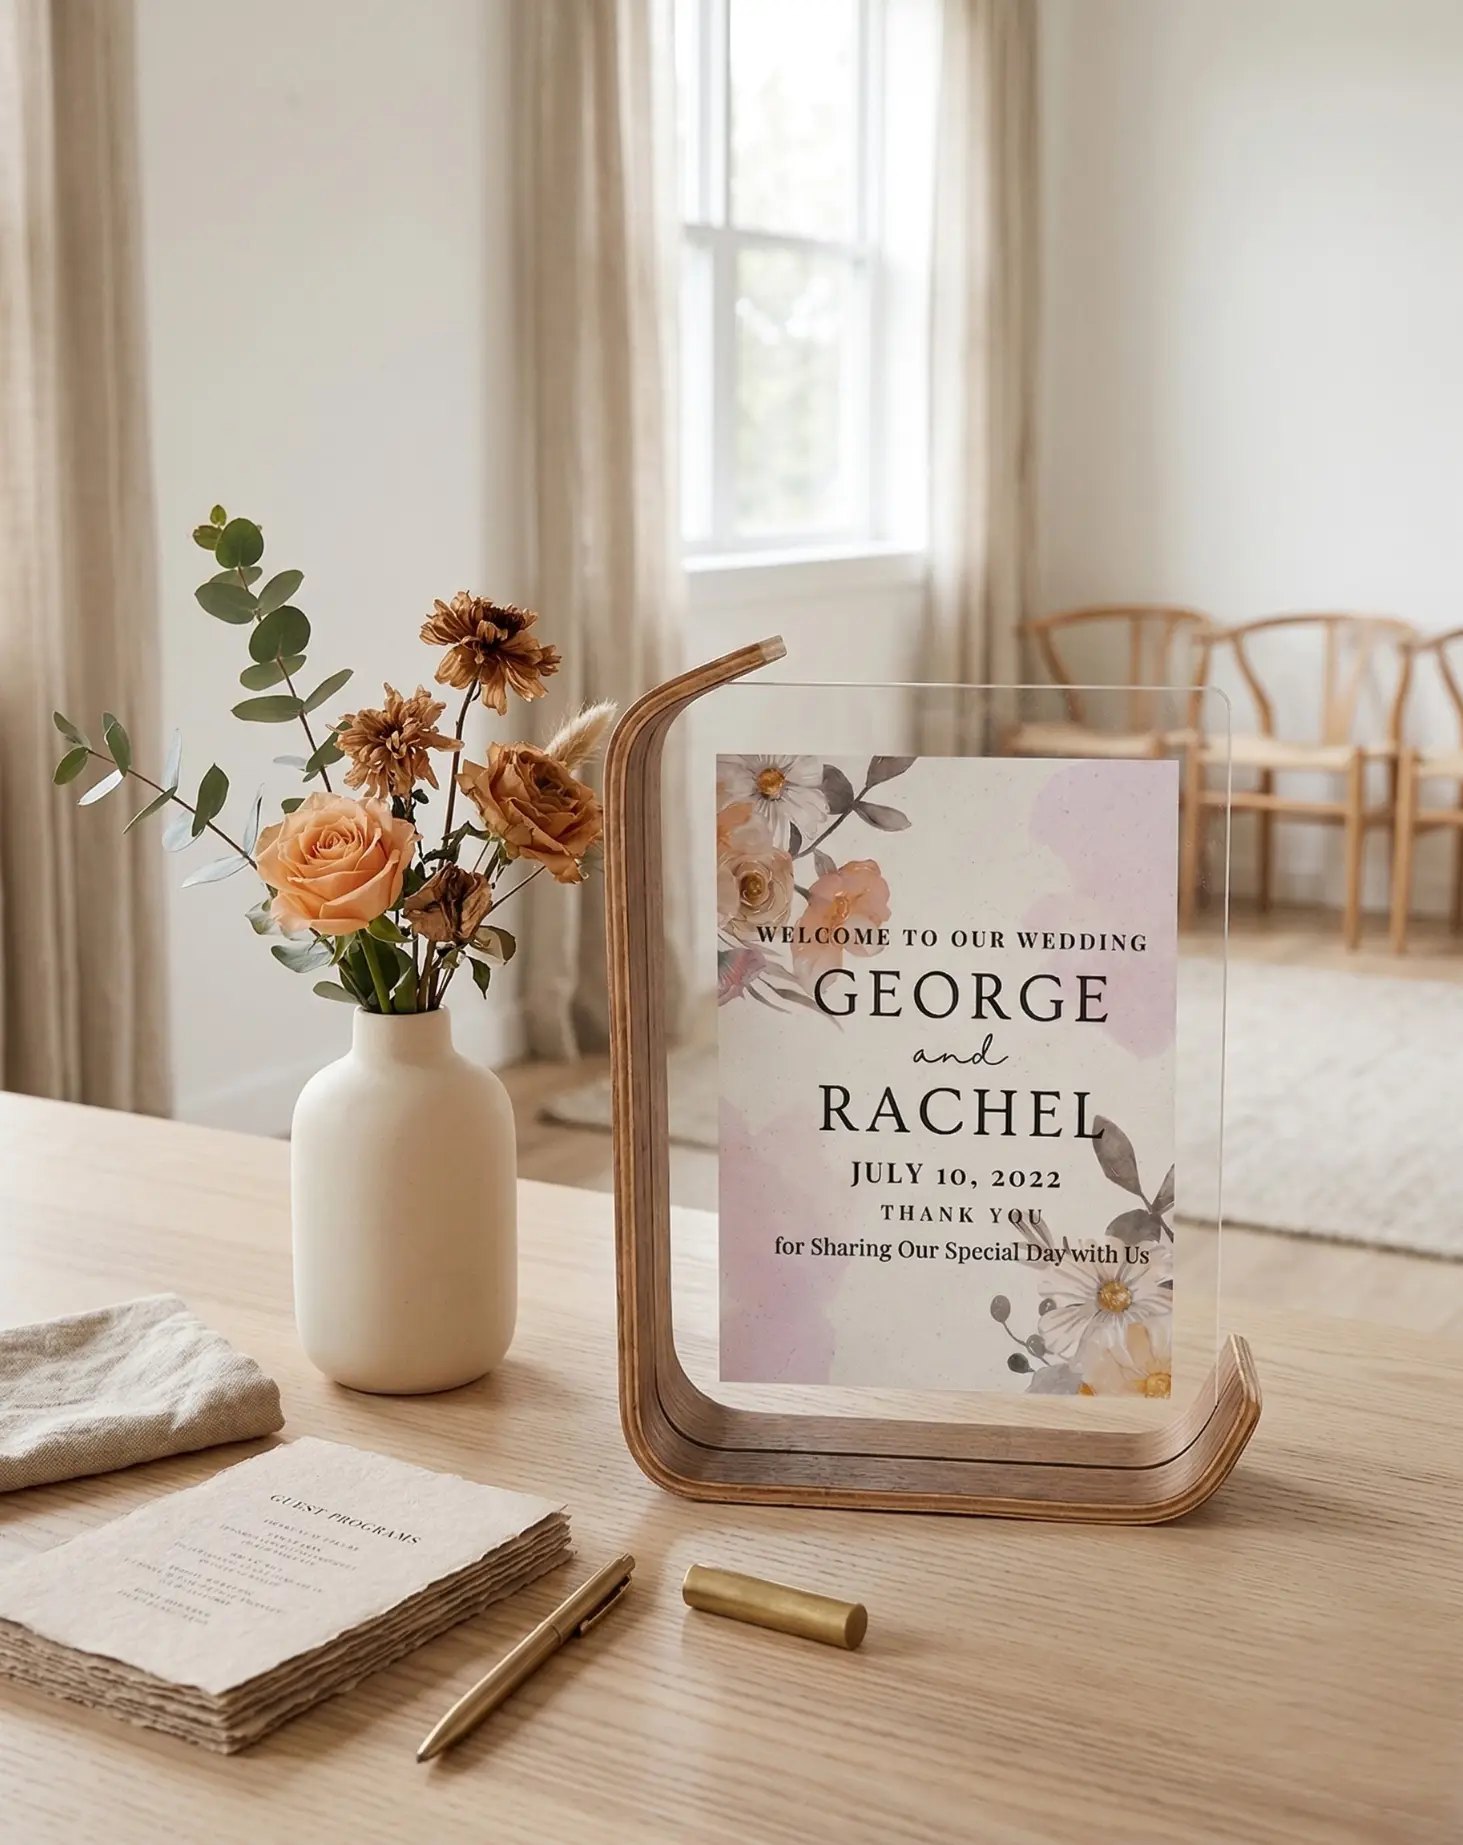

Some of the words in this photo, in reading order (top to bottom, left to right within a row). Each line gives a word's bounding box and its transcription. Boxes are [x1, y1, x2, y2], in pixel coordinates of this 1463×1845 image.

[756, 926, 890, 946] WELCOME
[902, 929, 938, 947] TO
[951, 930, 1005, 949] OUR
[1017, 931, 1147, 952] WEDDING
[813, 968, 1109, 1023] GEORGE
[912, 1033, 1009, 1066] and
[818, 1084, 1105, 1139] RACHEL
[850, 1161, 923, 1188] JULY
[937, 1168, 977, 1189] 10,
[991, 1170, 1061, 1189] 2022
[880, 1204, 974, 1223] THANK
[989, 1207, 1042, 1226] YOU
[775, 1236, 805, 1256] for
[811, 1237, 893, 1262] Sharing
[898, 1240, 940, 1259] Our
[945, 1240, 1020, 1265] Special
[1026, 1243, 1066, 1267] Day
[1070, 1245, 1118, 1264] with
[1124, 1245, 1150, 1265] Us
[270, 1493, 328, 1516] GUEST
[327, 1511, 423, 1546] PROGRAMS
